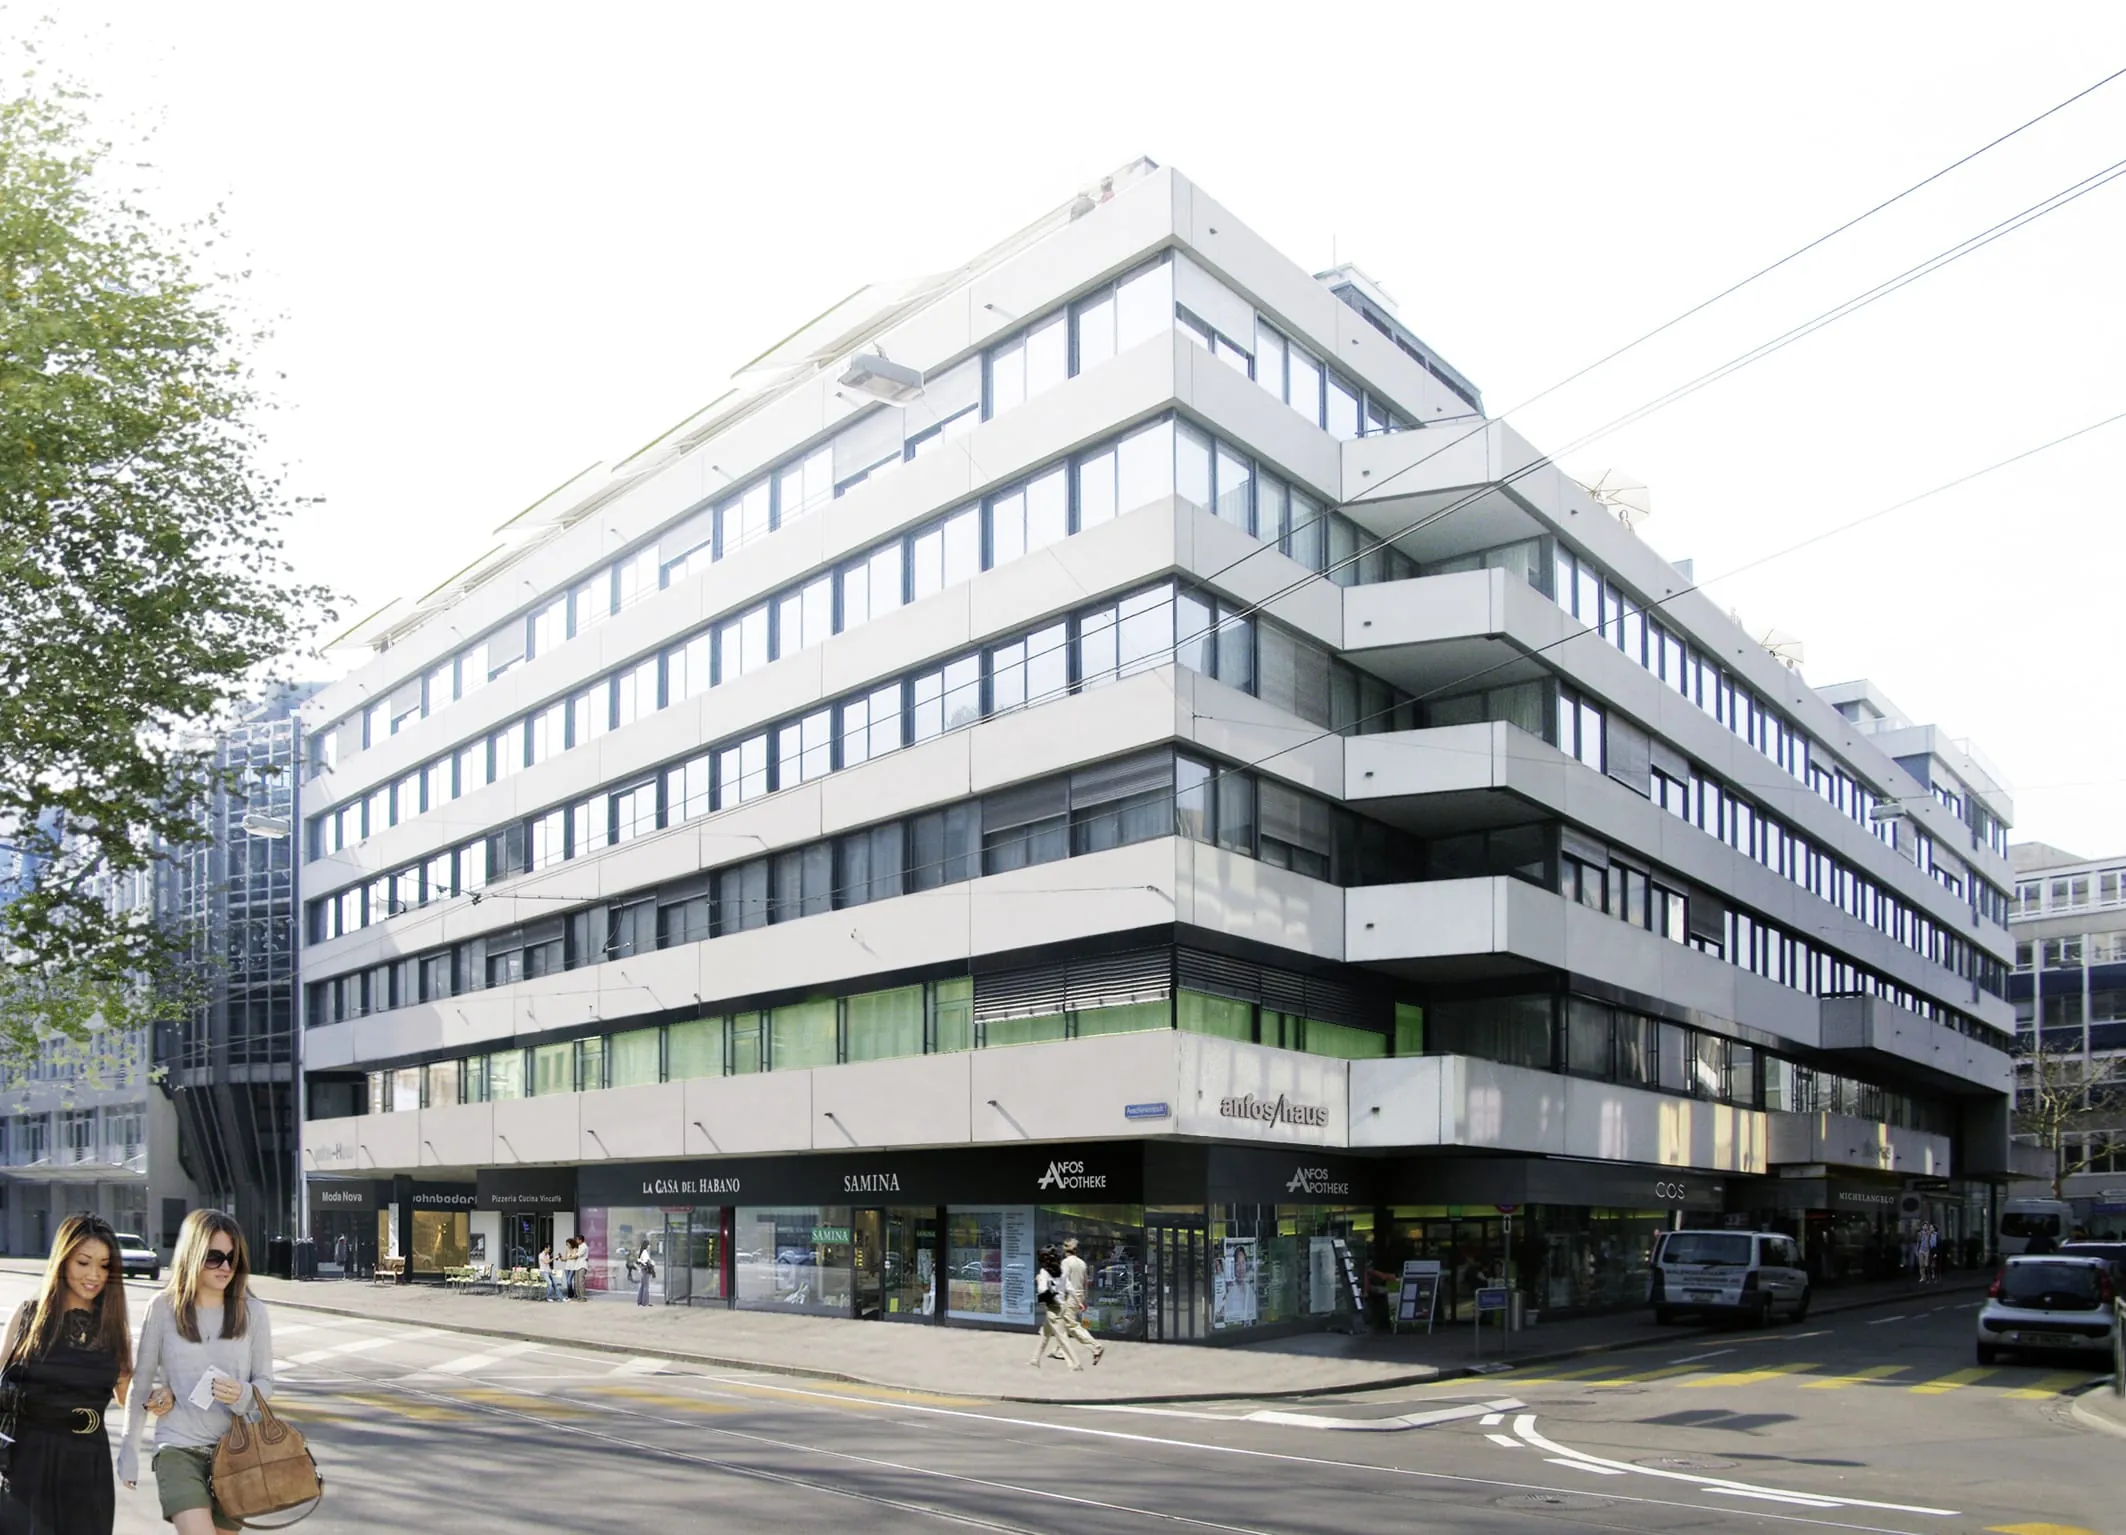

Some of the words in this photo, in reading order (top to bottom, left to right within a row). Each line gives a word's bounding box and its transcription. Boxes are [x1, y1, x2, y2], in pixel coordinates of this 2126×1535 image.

[642, 1182, 653, 1194] LA
[655, 1179, 679, 1194] CASA
[681, 1181, 697, 1193] DEL
[699, 1178, 741, 1193] HABANO
[844, 1173, 900, 1192] SAMINA
[321, 1191, 342, 1201] Moda
[342, 1191, 363, 1201] Nova
[1655, 1181, 1686, 1200] COS
[491, 1194, 517, 1203] Pizzeria
[1839, 1191, 1895, 1205] MICHELANGELO
[811, 1229, 849, 1242] SAMINA
